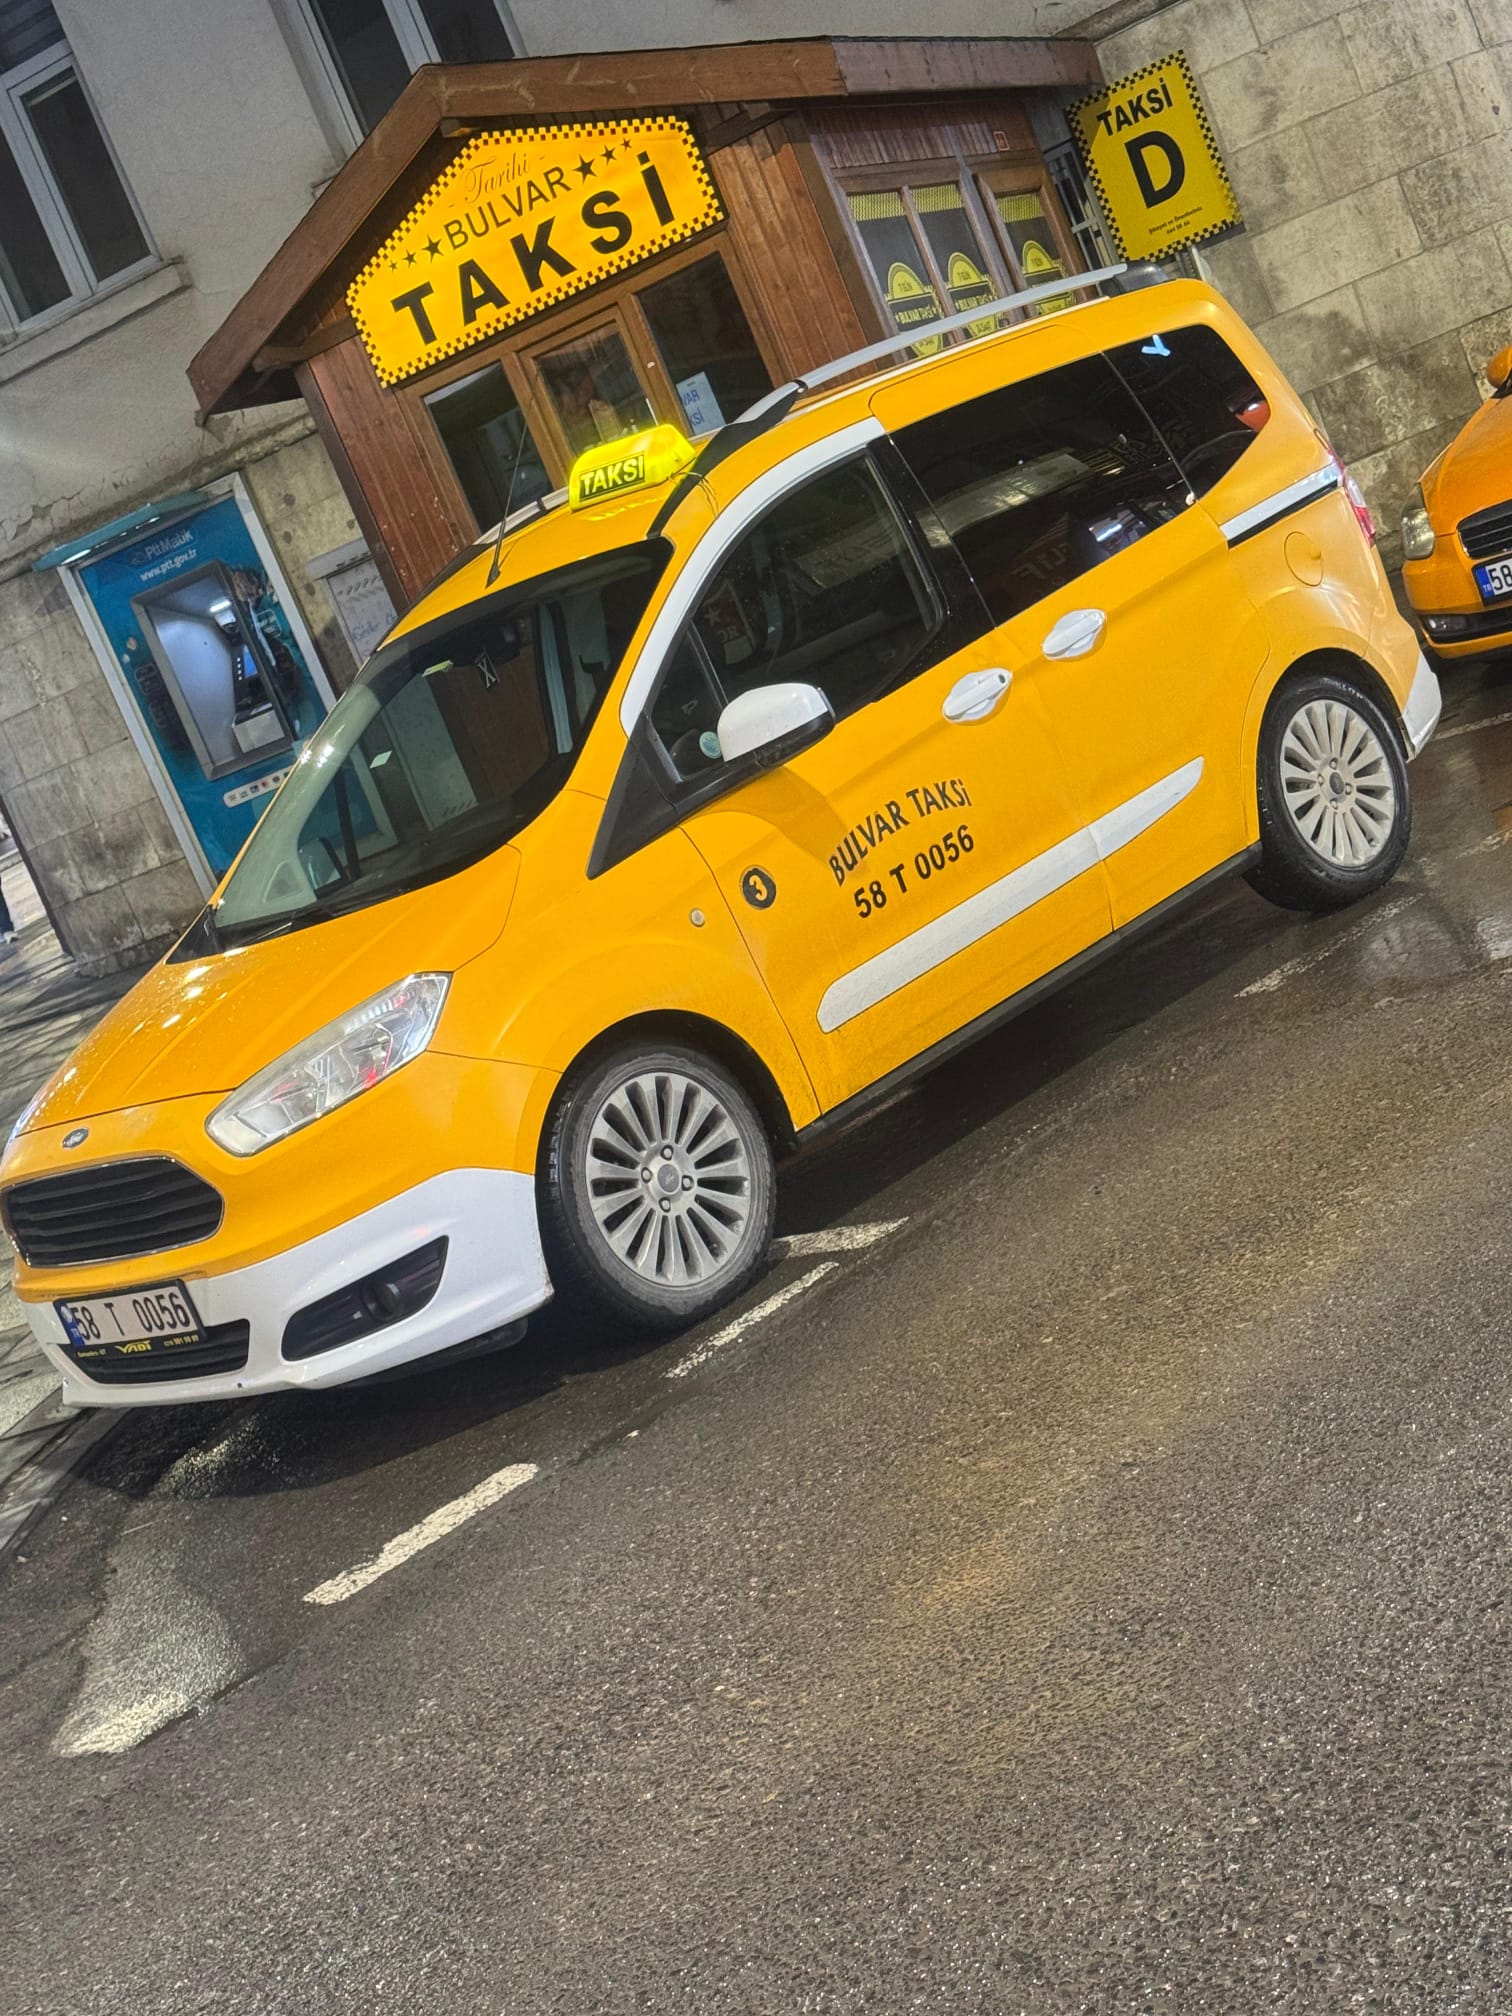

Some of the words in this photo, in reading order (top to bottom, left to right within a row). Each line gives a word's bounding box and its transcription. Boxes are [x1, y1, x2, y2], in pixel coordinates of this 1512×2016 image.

[1097, 77, 1173, 136] TAKSİ
[443, 165, 573, 251] BULVAR
[464, 153, 530, 202] Tarihi
[1124, 130, 1186, 210] D
[390, 149, 676, 346] TAKSİ
[828, 800, 911, 887] BULVAR
[853, 880, 888, 918] 58
[889, 863, 908, 894] T
[914, 824, 975, 880] 0056
[71, 1306, 101, 1340] 58
[103, 1302, 125, 1336] T
[132, 1292, 190, 1333] 0056
